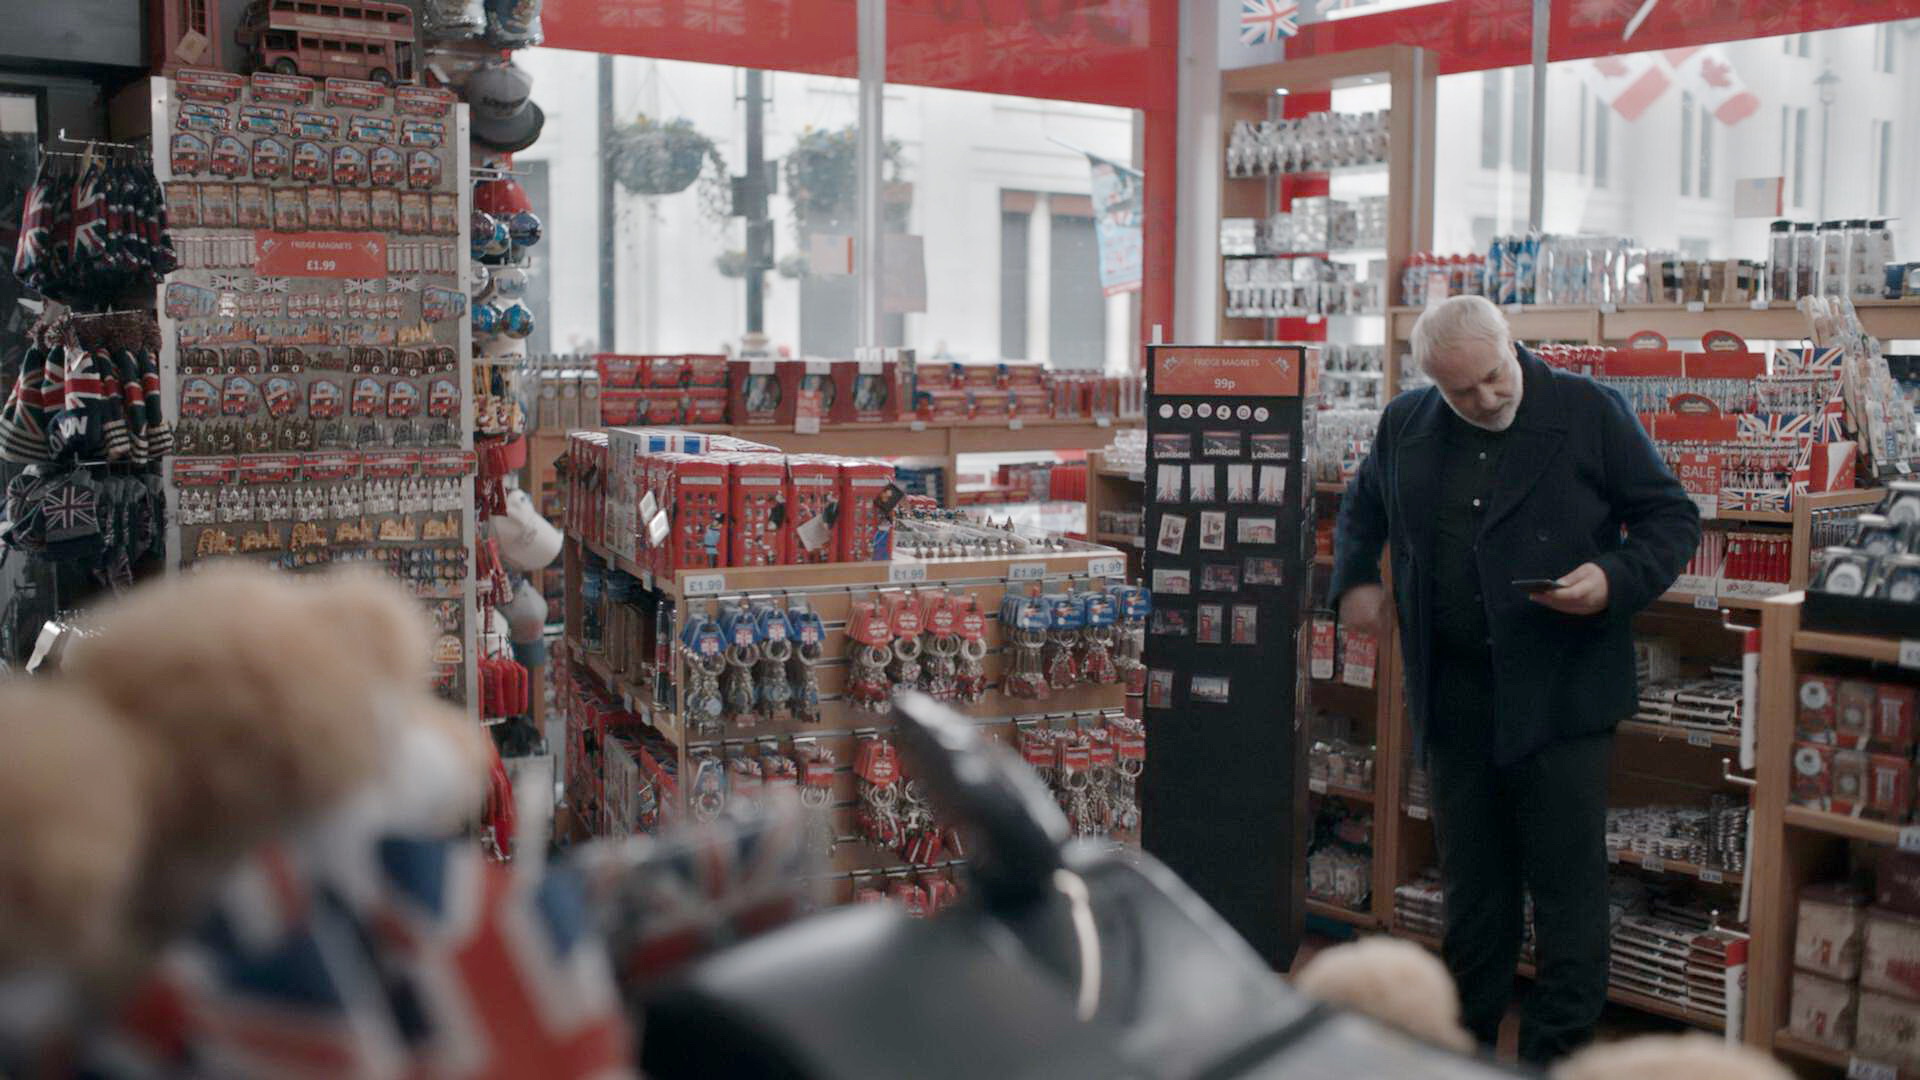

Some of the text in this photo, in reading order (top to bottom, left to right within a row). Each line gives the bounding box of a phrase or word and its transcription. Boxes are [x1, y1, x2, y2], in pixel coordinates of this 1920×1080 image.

[306, 260, 336, 271] £1.99
[1193, 358, 1260, 367] FRIDGE MAGNETS
[1214, 378, 1236, 390] 99p
[1154, 451, 1191, 459] LONDON
[1203, 448, 1241, 457] LONDON
[1251, 451, 1289, 459] LONDON
[1681, 465, 1716, 479] SALE
[1013, 567, 1045, 579] £1.99
[1092, 561, 1122, 573] £1.99
[893, 567, 924, 580] £1.99
[689, 579, 723, 592] £1.99
